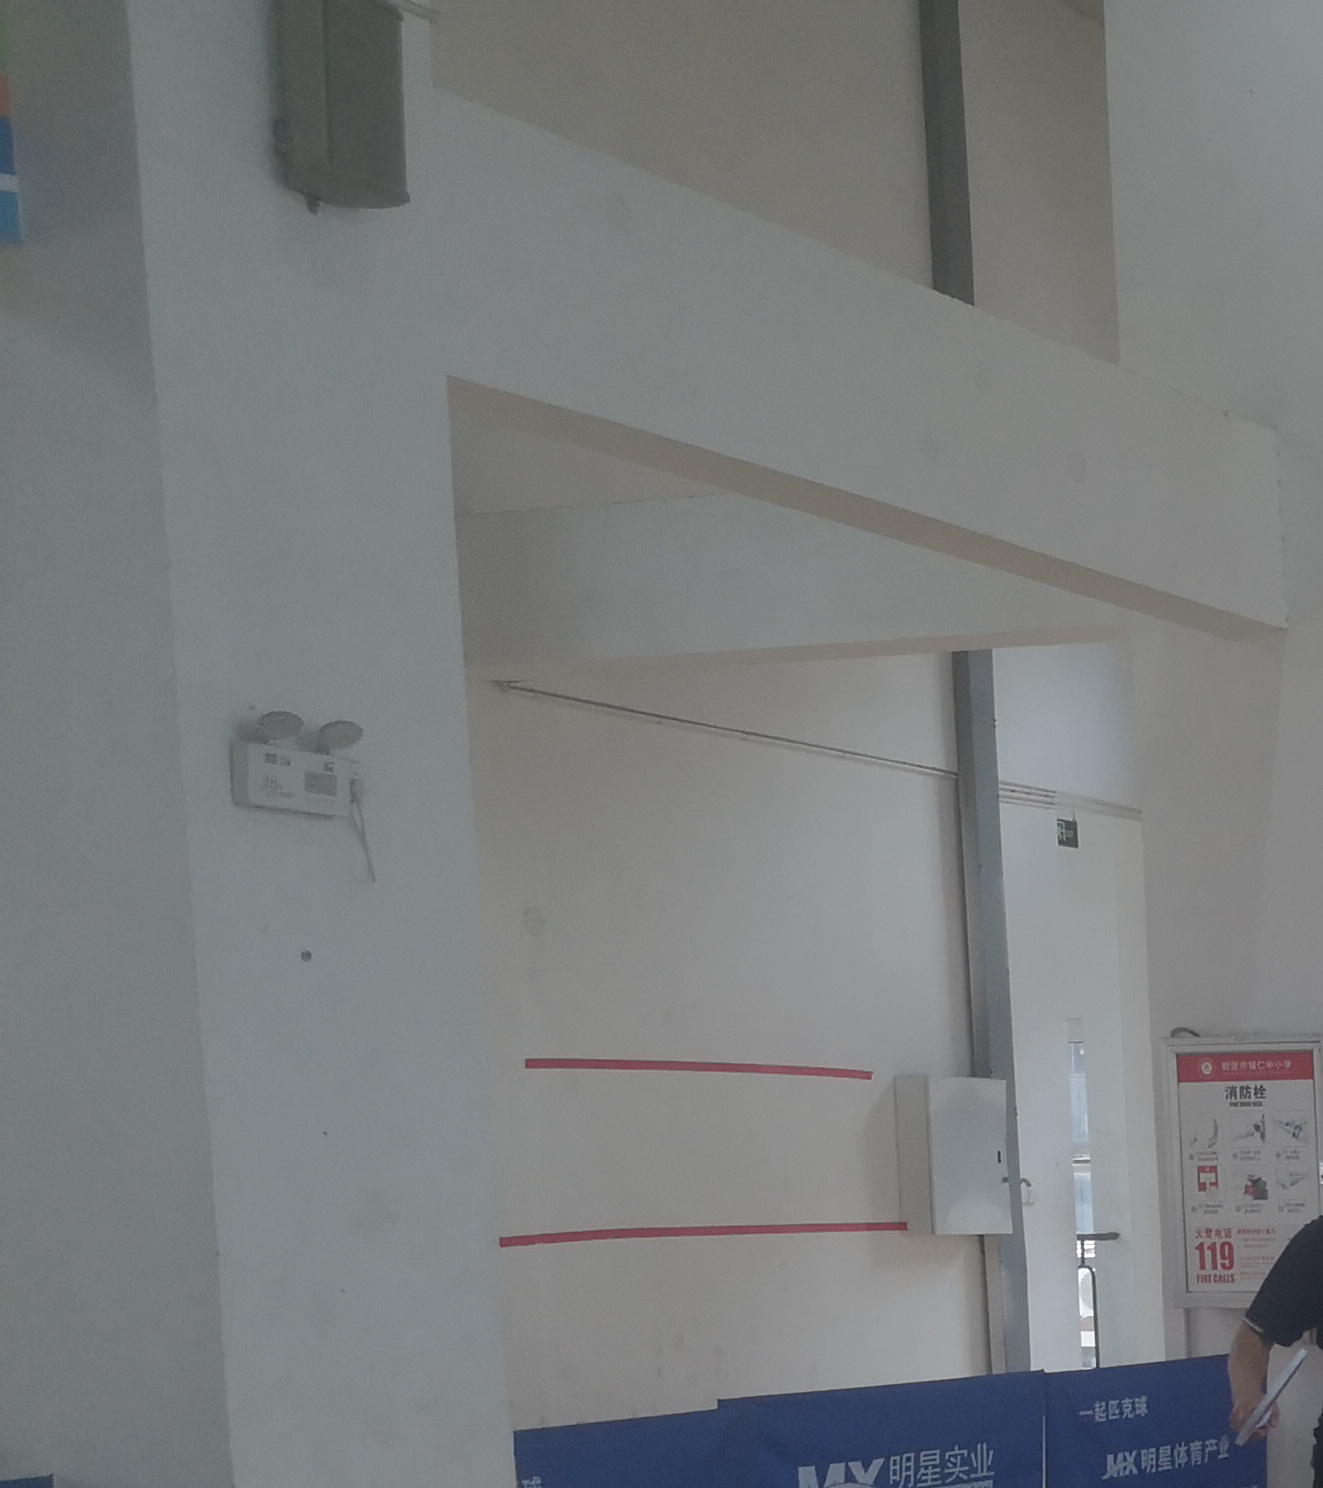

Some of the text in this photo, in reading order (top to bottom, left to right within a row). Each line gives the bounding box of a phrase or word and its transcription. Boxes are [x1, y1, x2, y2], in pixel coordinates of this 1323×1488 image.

[1224, 1084, 1267, 1100] 消防栓
[1194, 1241, 1235, 1271] 119
[1079, 1396, 1148, 1422] 一起匹克球
[889, 1443, 995, 1488] 明星实业
[1140, 1435, 1230, 1474] 明星体育产业
